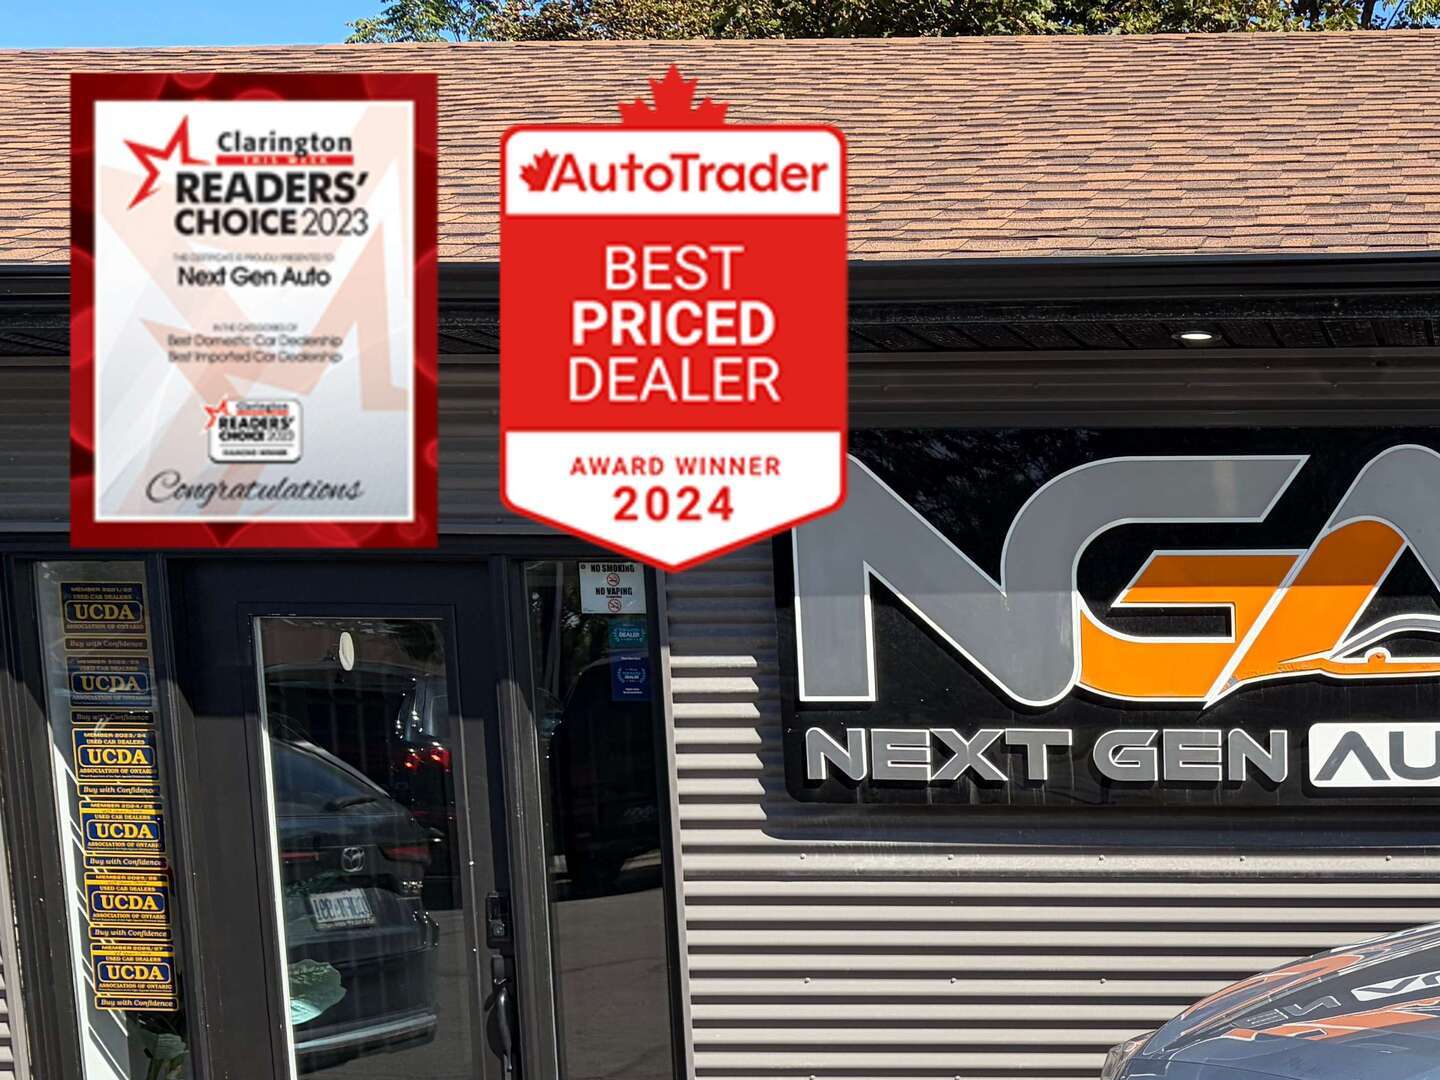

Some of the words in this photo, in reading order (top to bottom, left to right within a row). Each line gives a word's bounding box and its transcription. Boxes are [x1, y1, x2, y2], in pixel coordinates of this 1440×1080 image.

[590, 564, 600, 573] NO
[601, 564, 636, 573] SMOKING
[595, 587, 605, 595] NO
[606, 587, 633, 596] VAPING
[73, 604, 136, 620] UCDA
[70, 640, 84, 648] Buy
[102, 640, 144, 649] Confidence
[80, 675, 144, 692] UCDA
[87, 749, 148, 764] UCDA
[804, 727, 1074, 783] NEXT
[1091, 727, 1288, 783] GEN
[83, 786, 98, 794] Buy
[94, 823, 154, 839] UCDA
[90, 858, 104, 866] Buy
[100, 895, 159, 910] UCDA
[94, 929, 110, 937] Buy
[127, 930, 168, 938] Confidence
[105, 965, 164, 981] UCDA
[133, 1000, 174, 1008] Confidence
